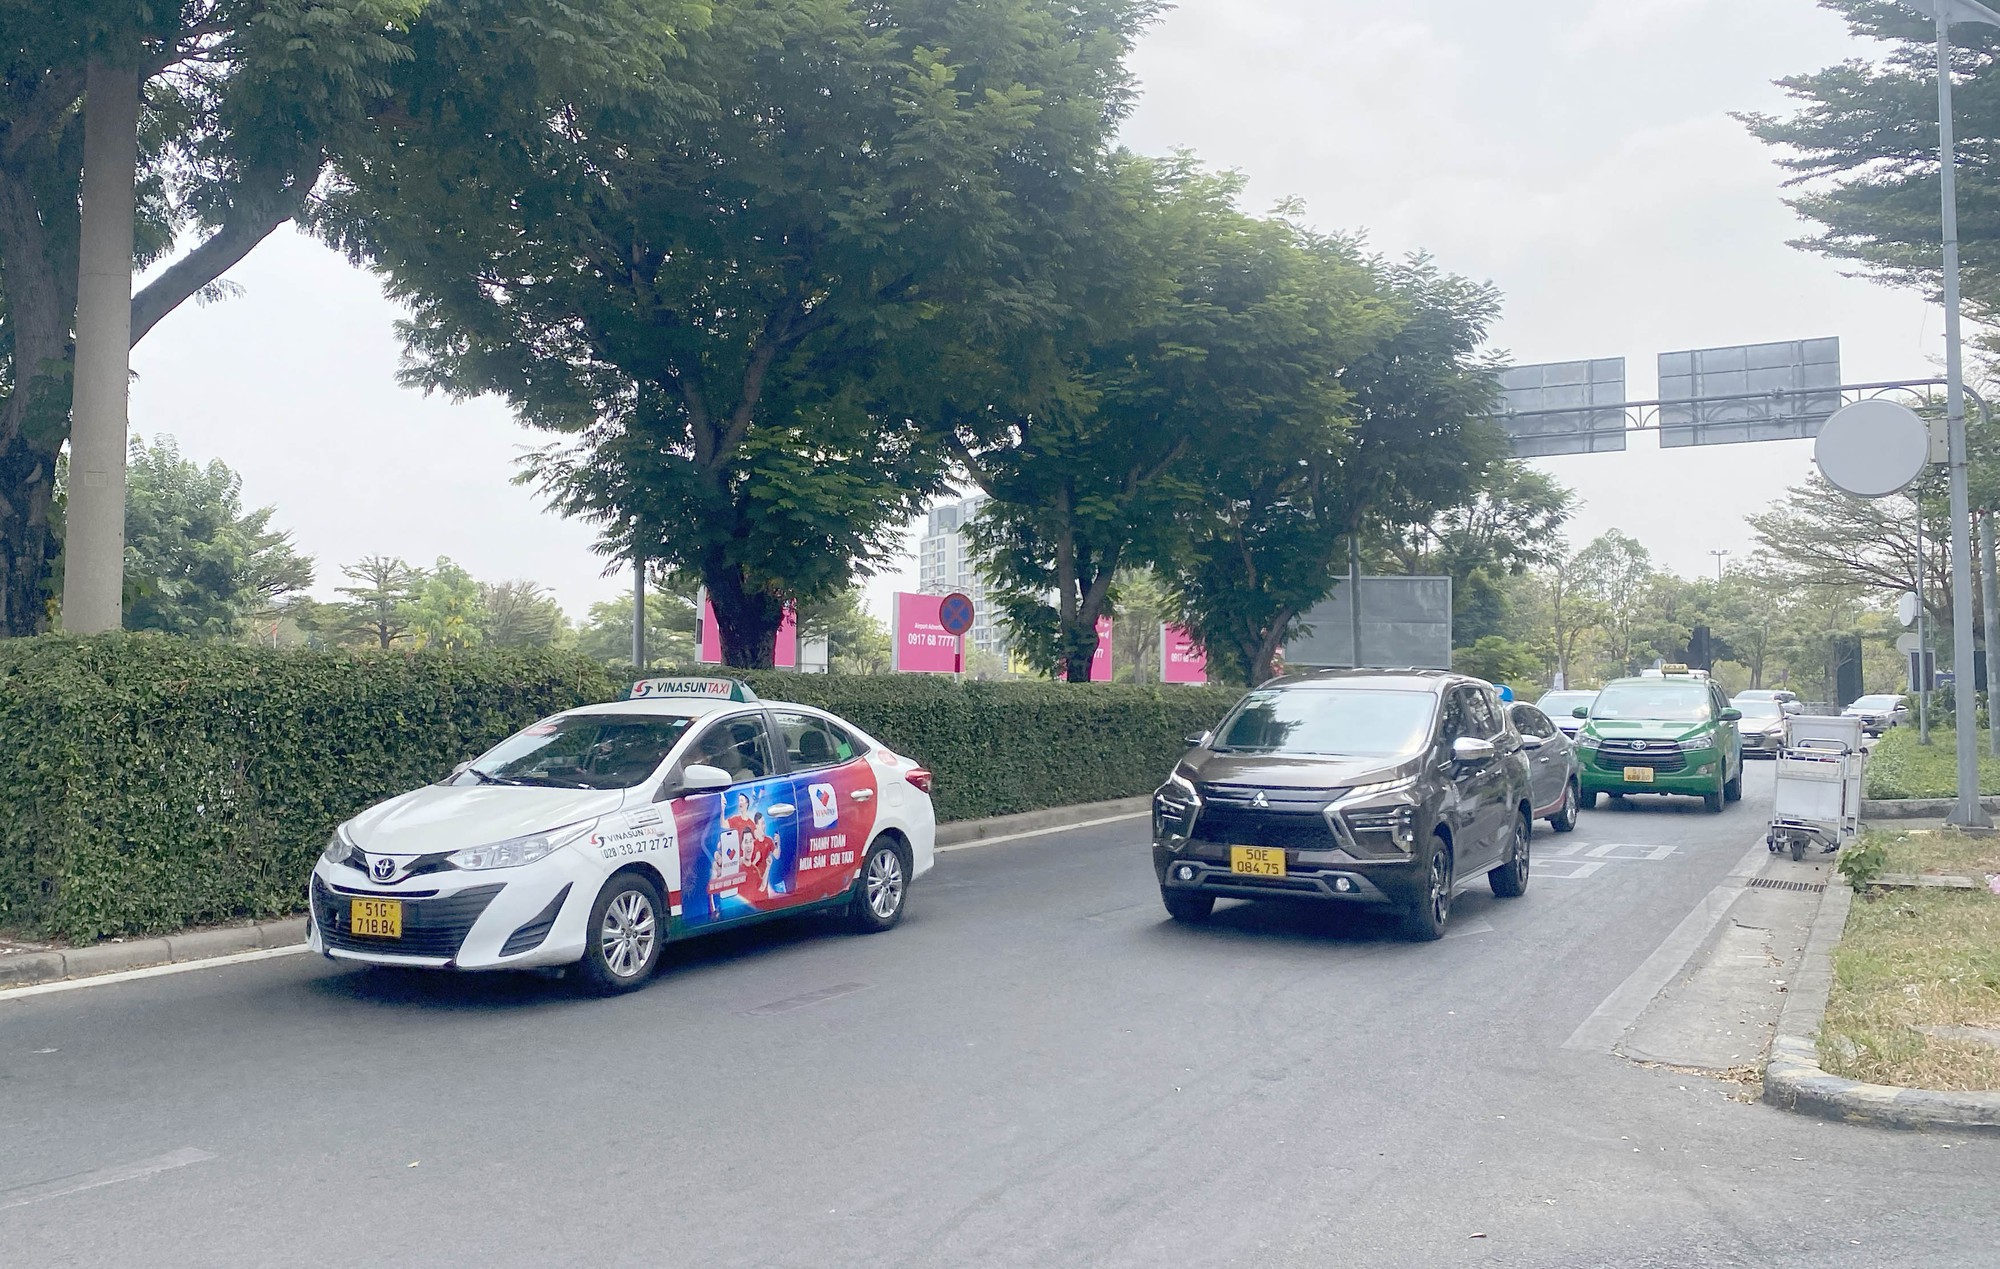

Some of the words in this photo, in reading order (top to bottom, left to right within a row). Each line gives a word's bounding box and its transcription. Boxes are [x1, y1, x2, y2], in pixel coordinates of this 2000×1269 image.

[908, 633, 926, 645] 0917
[927, 634, 936, 646] 68
[938, 635, 955, 647] 7777
[657, 682, 730, 695] VINASUNTAXI
[649, 838, 660, 851] 27
[663, 836, 673, 848] 27
[809, 836, 830, 852] THANH
[799, 857, 813, 871] MUA
[841, 850, 854, 864] TAXI
[1245, 849, 1269, 861] 50E
[1237, 861, 1279, 875] 084.75
[365, 902, 387, 917] 51G
[357, 918, 395, 935] 718.84
